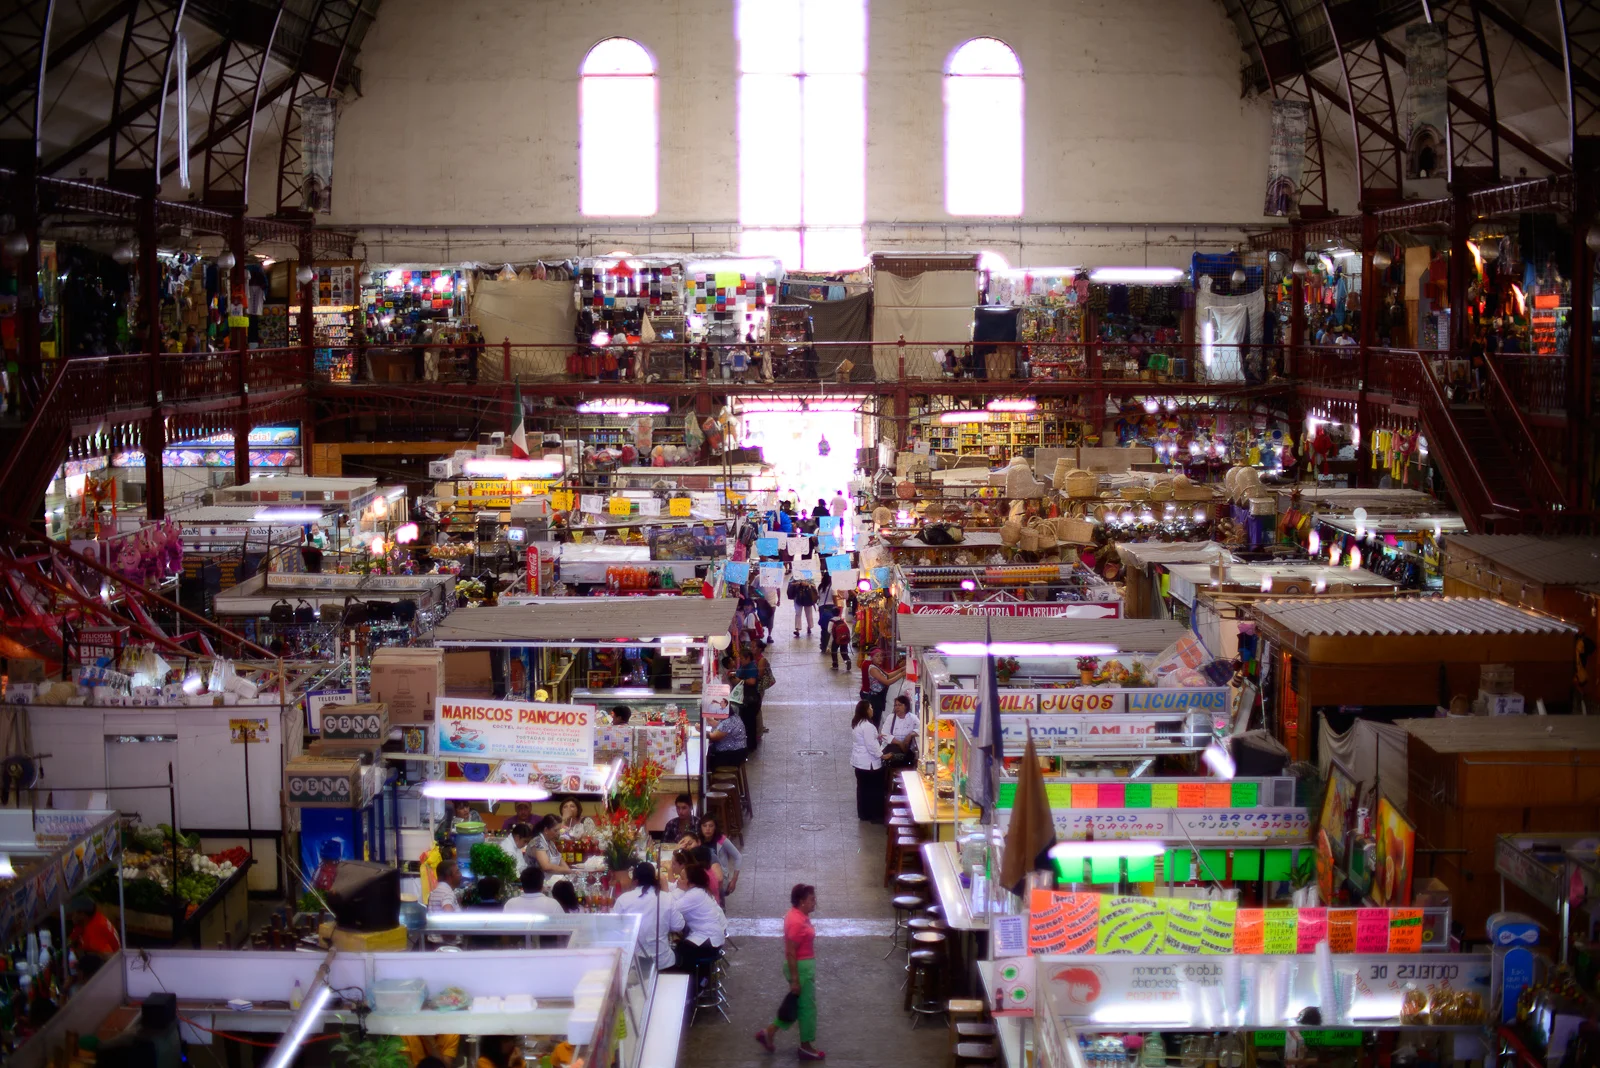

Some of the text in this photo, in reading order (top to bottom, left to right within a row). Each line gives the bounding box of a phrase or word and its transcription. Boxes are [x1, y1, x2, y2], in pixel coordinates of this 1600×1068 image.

[966, 605, 1011, 617] CREMERIA
[80, 645, 115, 658] BIEN
[1041, 693, 1115, 712] JUGOS
[1131, 692, 1226, 709] LICUADOS
[441, 704, 588, 726] MARISCOS PANCHO'S
[325, 717, 379, 731] GENA
[291, 779, 349, 793] GENA
